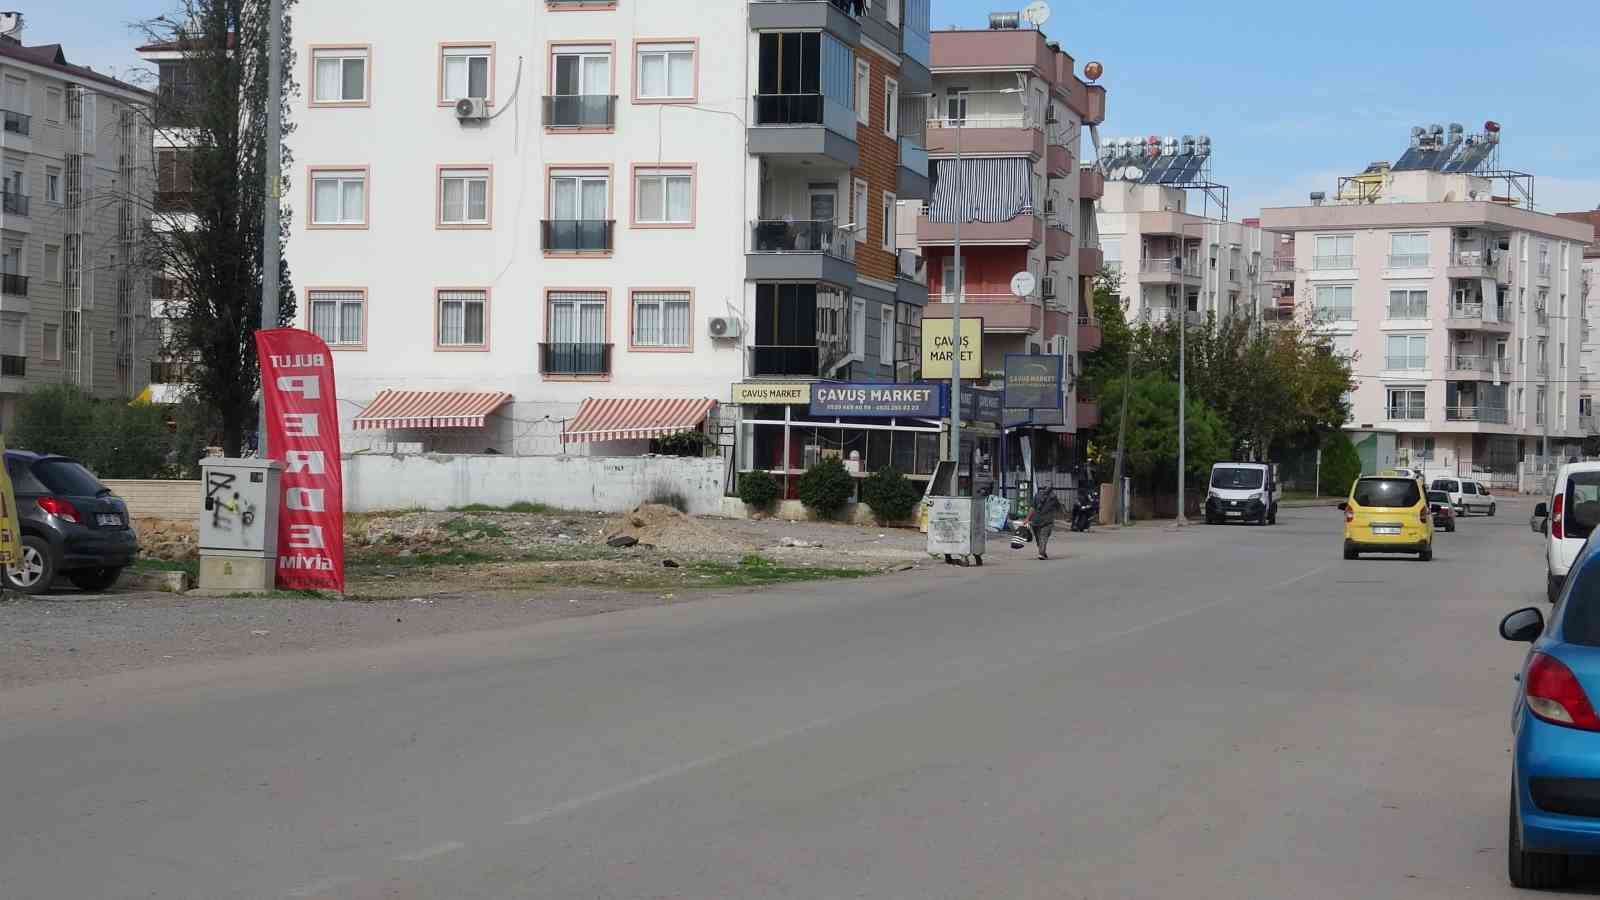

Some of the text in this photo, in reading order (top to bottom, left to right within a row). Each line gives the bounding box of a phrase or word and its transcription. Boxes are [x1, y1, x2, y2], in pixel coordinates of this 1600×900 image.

[934, 336, 969, 349] ÇAVŞ
[930, 351, 973, 361] MARET
[769, 389, 801, 398] MARKET
[817, 388, 931, 404] ÇAVUŞ MARKET
